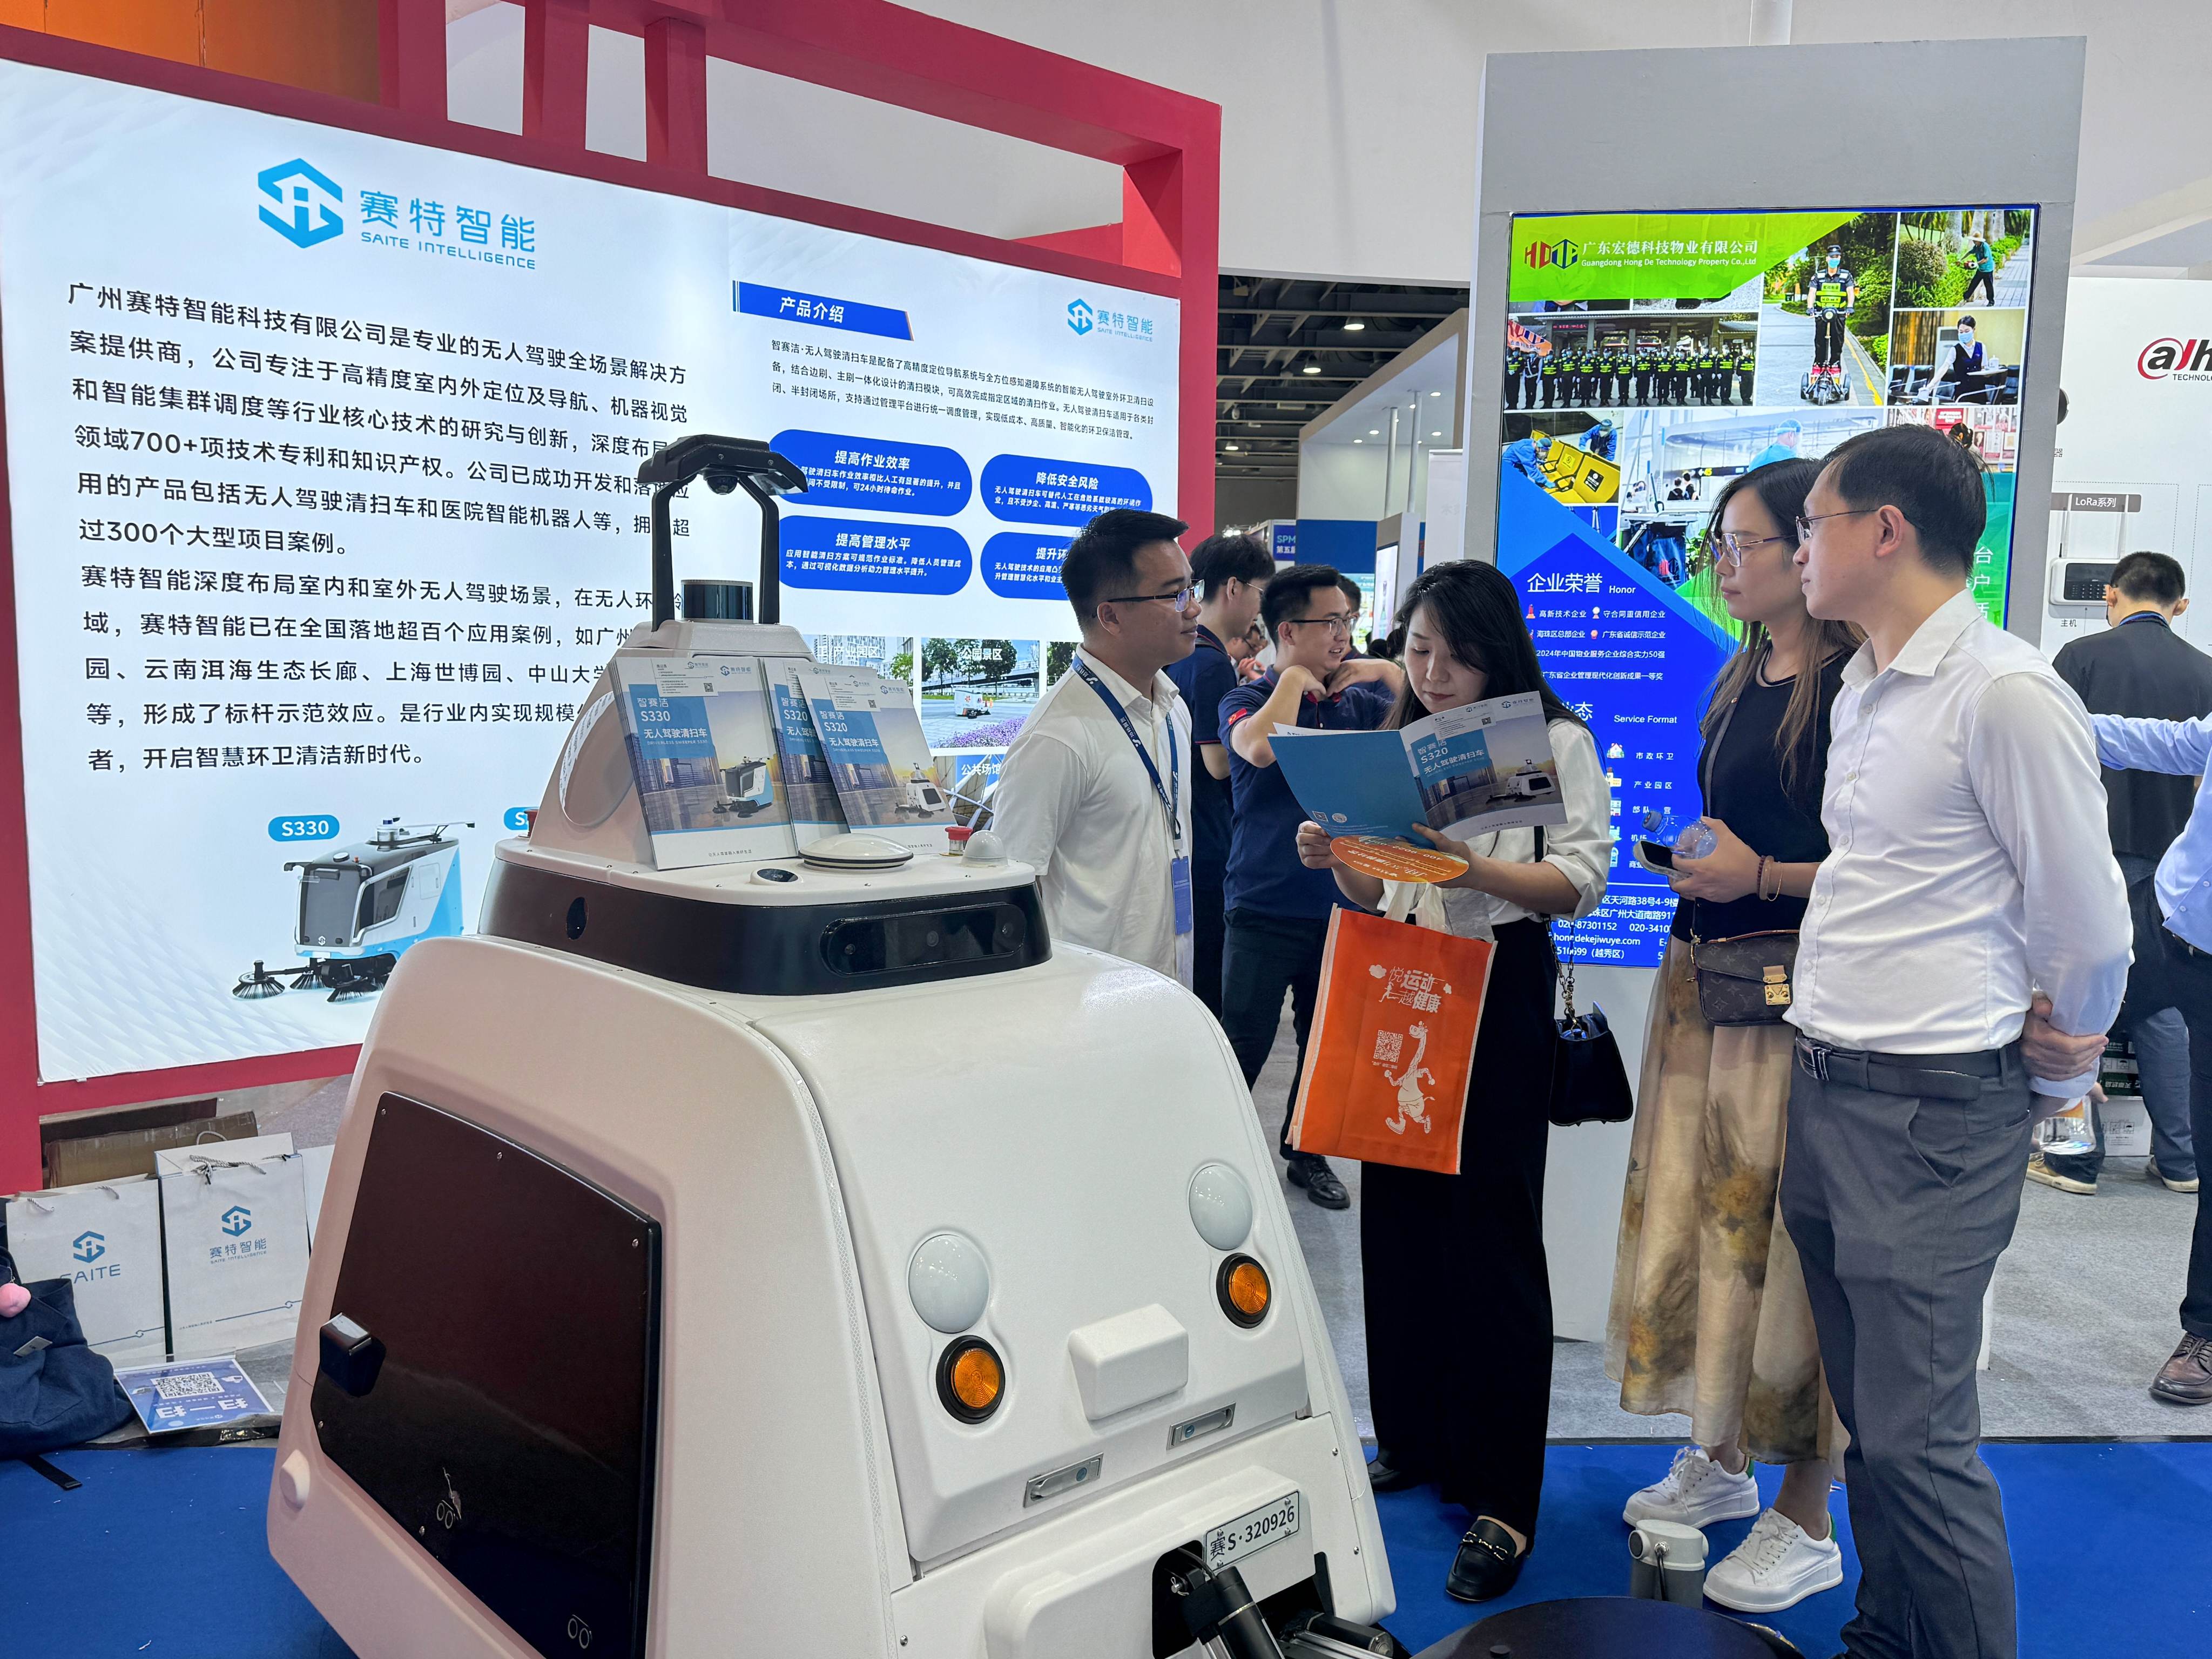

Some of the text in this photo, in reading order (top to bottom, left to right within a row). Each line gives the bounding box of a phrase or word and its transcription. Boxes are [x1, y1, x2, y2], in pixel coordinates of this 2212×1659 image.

[360, 190, 535, 253] 赛特智能
[361, 232, 535, 269] SAITE INTELLIGENCE
[1582, 240, 1758, 256] 广东宏德科技物业有限公司
[1581, 258, 1622, 268] Guangdong
[1623, 258, 1642, 267] Hong
[1656, 258, 1696, 267] Technology
[1698, 258, 1729, 267] Property
[1731, 258, 1756, 266] Co.,Ltd
[779, 296, 845, 323] 产品介绍
[1097, 310, 1152, 334] 赛特智能
[68, 282, 686, 385] 广州赛特智能科技有限公司是专业的无人驾驶全场景解决方
[70, 331, 687, 423] 案提供商，公司专注于高精度室内外定位及导航、机器视觉
[75, 424, 689, 499] 领域700+项技术专利和知识产权。公司已成功开发和落应
[834, 449, 910, 471] 提高作业效率
[807, 478, 915, 497] 间不受限制，可24小时待命作业。
[1036, 471, 1098, 490] 降低安全风险
[77, 472, 690, 536] 用的产品包括无人驾驶清扫车和医院智能机器人等，拥超
[2075, 496, 2116, 508] LoRa系列
[79, 518, 345, 555] 过300个大型项目案例。
[835, 532, 911, 551] 提高管理水平
[82, 565, 683, 610] 赛特智能深度布局室内和室外无人驾驶场景，在无人环
[1527, 572, 1602, 594] 企业荣誉
[1609, 585, 1636, 594] Honor
[1539, 610, 1665, 619] 高新技术企业 守合同重信用企业
[2060, 619, 2077, 628] 主机
[1536, 630, 1665, 639] 海珠区总部企业 广东省诚信示范企业
[961, 648, 1002, 660] 公园景区
[637, 698, 669, 707] 智赛洁
[86, 703, 583, 727] 等，形成了标杆示范效应。是行业内实现规模
[641, 711, 671, 721] S330
[784, 709, 808, 721] S320
[1614, 714, 1677, 724] Service Format
[644, 727, 707, 739] 无人驾驶清扫车
[825, 722, 847, 732] S320
[829, 738, 879, 747] 无人驾驶清扫车
[88, 744, 423, 773] 者，开启智慧环卫清洁新时代。
[1421, 747, 1448, 764] S320
[1424, 750, 1485, 774] 无人驾驶清扫车
[1634, 781, 1672, 790] 产业园区
[281, 820, 329, 836] S330
[1588, 907, 1675, 920] 珠区广州大道南路91
[1629, 923, 1670, 933] 020-3410
[210, 1238, 267, 1259] 赛特智能
[156, 1398, 248, 1419] 扫一扫
